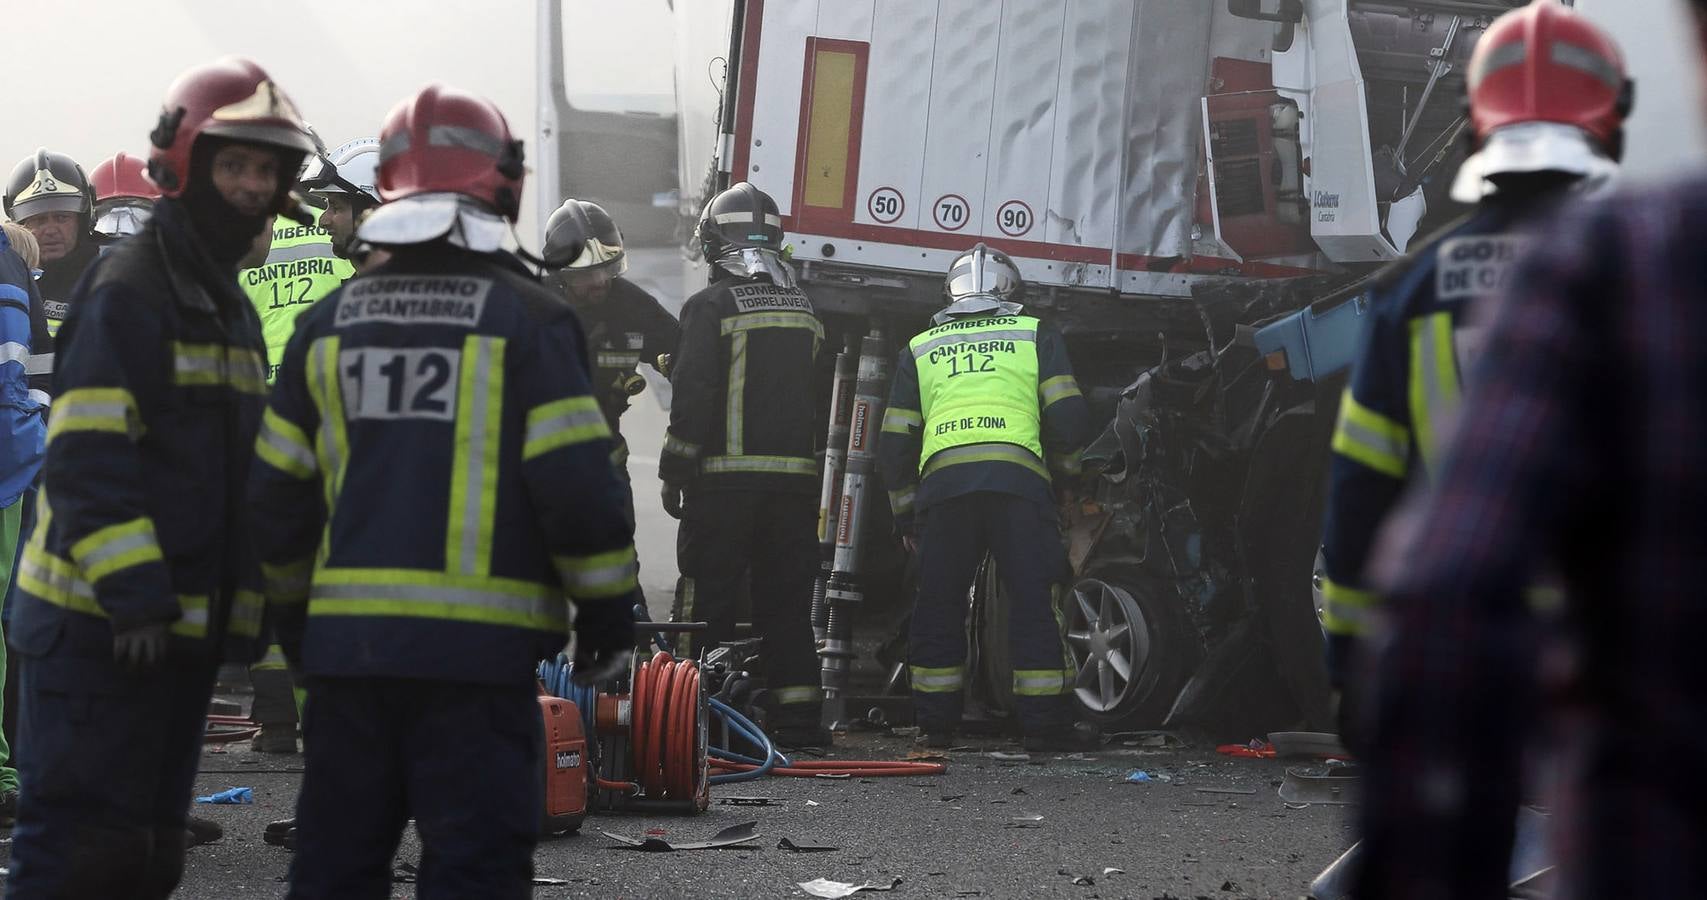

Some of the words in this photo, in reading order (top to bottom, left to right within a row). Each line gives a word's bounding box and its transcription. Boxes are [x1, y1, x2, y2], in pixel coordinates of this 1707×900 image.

[32, 177, 57, 195] 23
[875, 196, 898, 215] 50
[941, 204, 963, 223] 70
[1003, 209, 1027, 229] 90
[247, 259, 334, 286] CANTABRIA
[268, 277, 314, 310] 112
[351, 280, 479, 297] GOBIERNO
[341, 302, 360, 320] DE
[366, 299, 475, 319] CANTABRIA
[929, 317, 1018, 336] BOMBEROS
[929, 340, 1016, 364] CANTABRIA
[946, 353, 996, 378] 112
[346, 352, 451, 414] 112
[854, 404, 866, 447] holmatro
[934, 420, 958, 436] JEFE
[960, 417, 974, 430] DE
[976, 416, 1007, 430] ZONA
